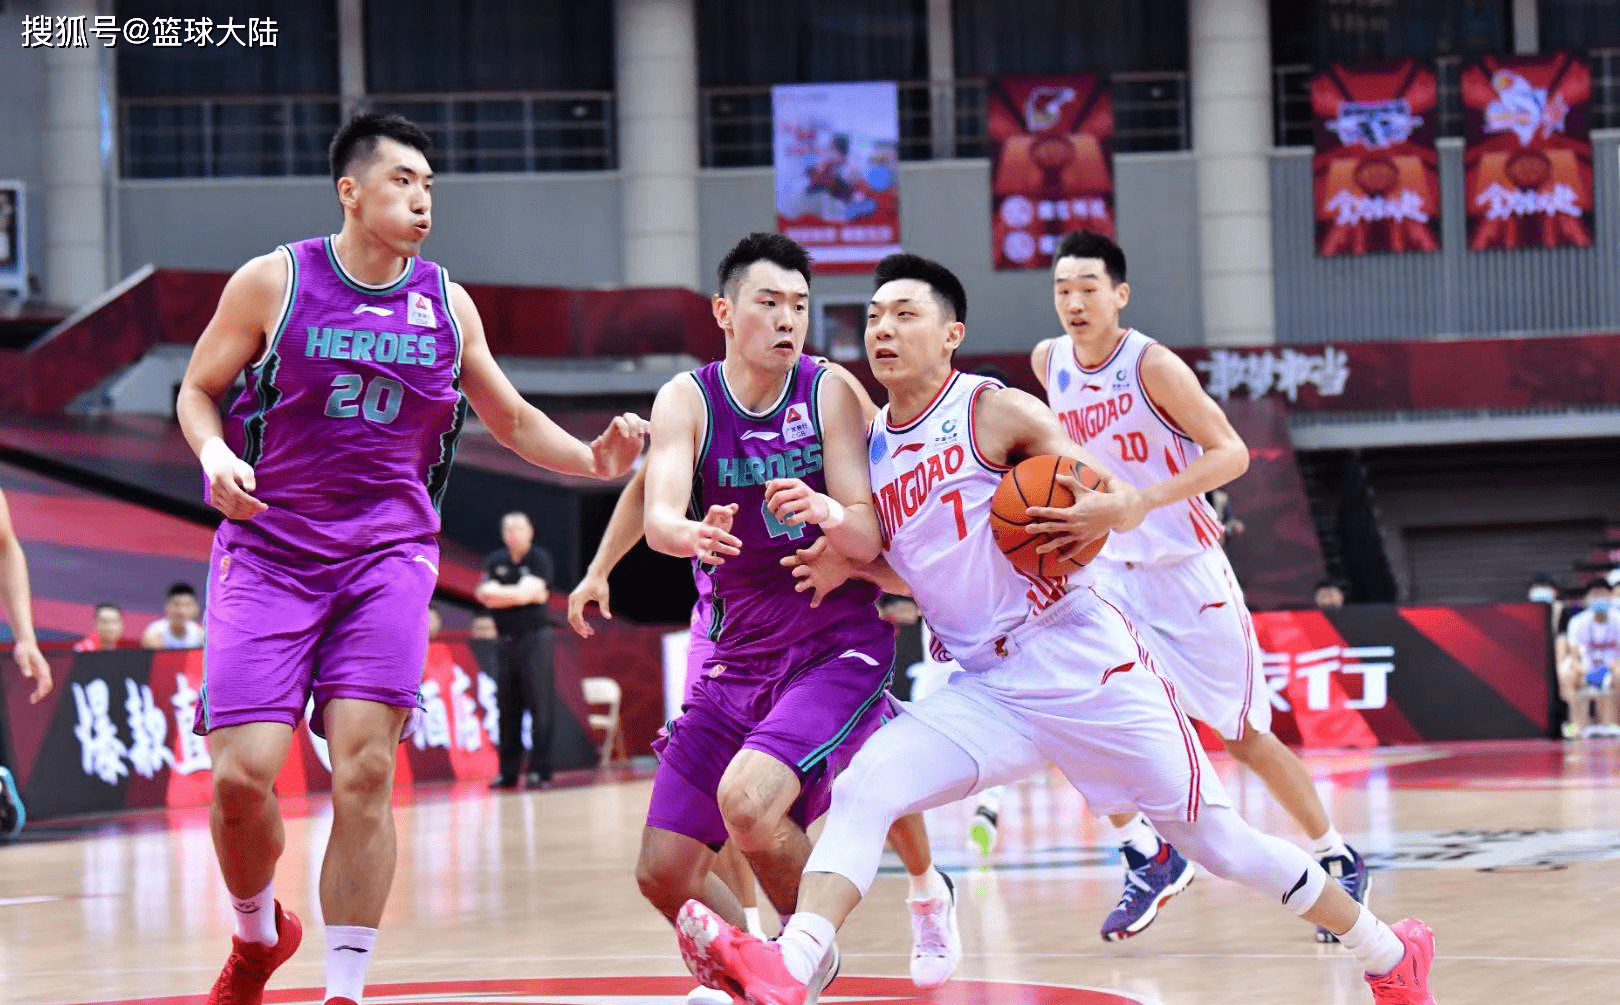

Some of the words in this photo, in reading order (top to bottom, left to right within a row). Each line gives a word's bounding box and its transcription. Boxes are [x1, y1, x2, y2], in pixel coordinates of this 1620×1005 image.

[305, 326, 437, 367] HEROES
[324, 374, 405, 425] 20
[1112, 432, 1149, 463] 20
[940, 489, 968, 541] 7
